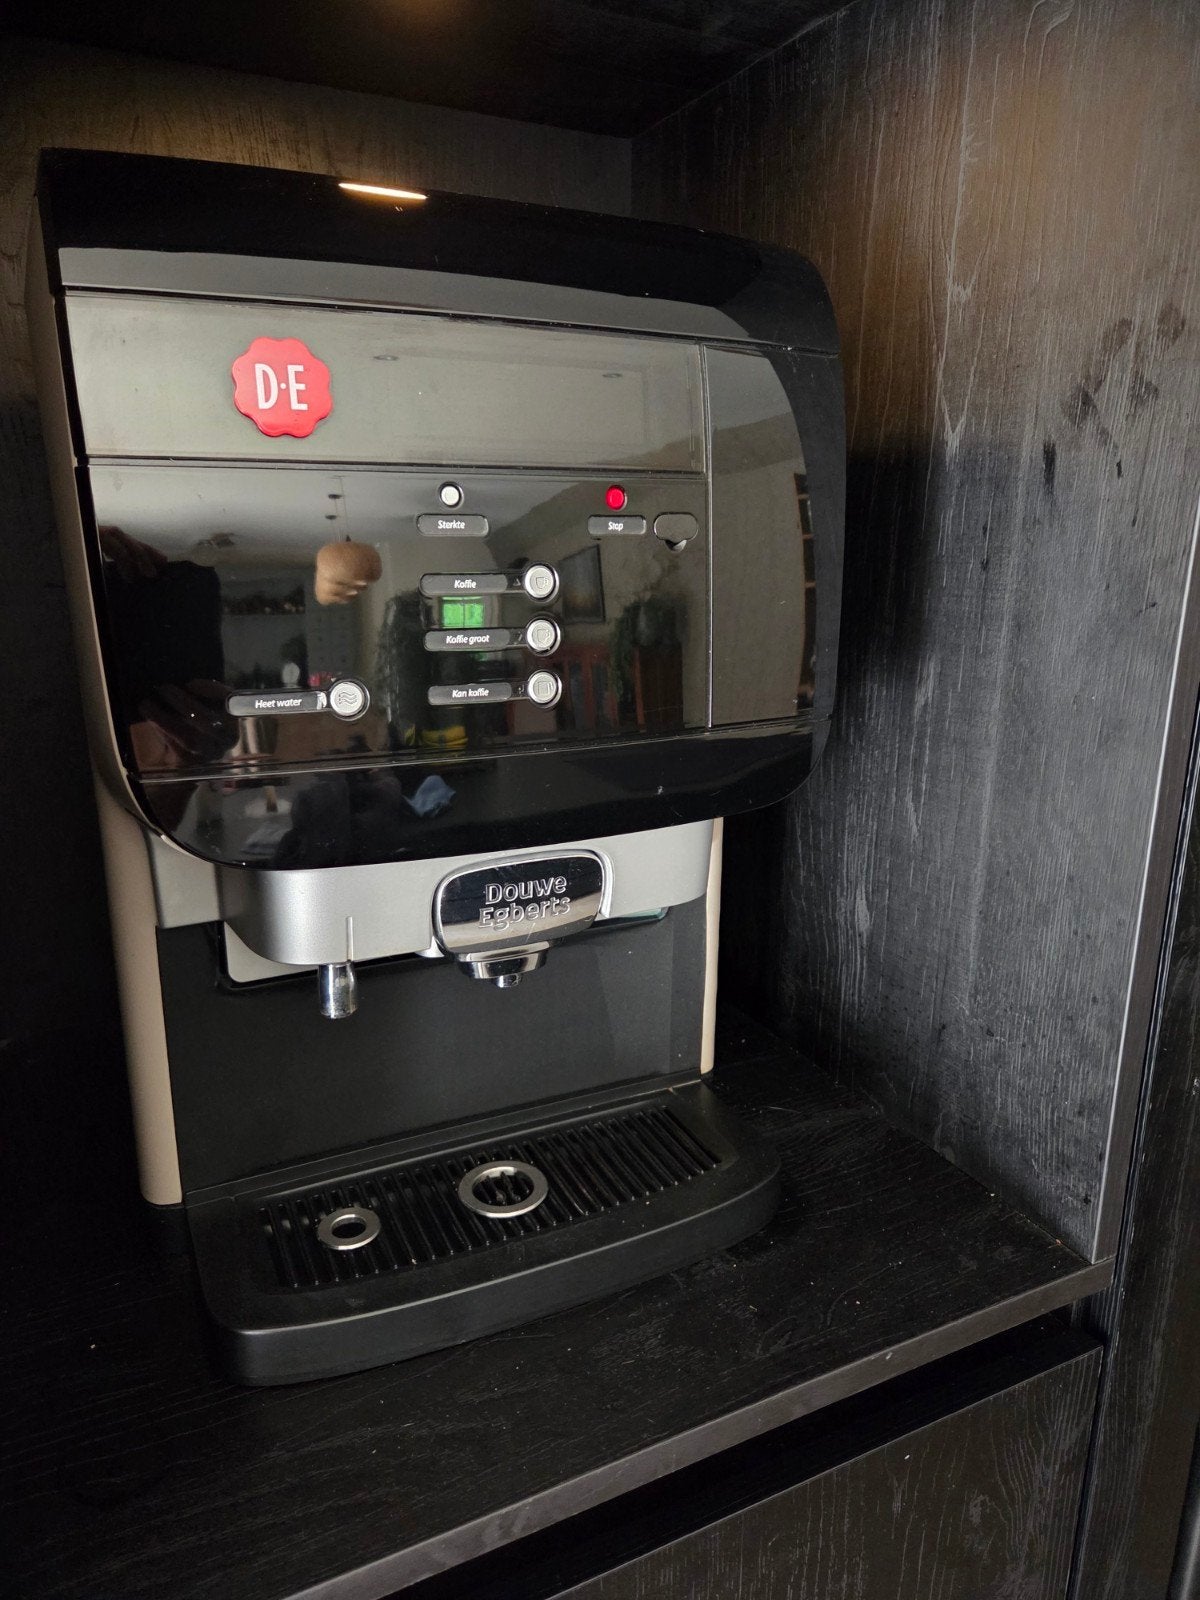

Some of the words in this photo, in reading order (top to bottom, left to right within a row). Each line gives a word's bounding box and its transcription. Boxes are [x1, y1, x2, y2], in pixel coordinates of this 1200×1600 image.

[437, 519, 466, 530] Sterkte
[607, 521, 624, 531] Stop
[453, 579, 477, 589] Koffie
[446, 634, 468, 644] Koffie
[469, 634, 489, 645] groot
[452, 689, 467, 698] Kan
[468, 688, 489, 698] koffie
[255, 699, 276, 709] Heet
[276, 698, 302, 708] water
[485, 875, 567, 905] Douwe
[478, 896, 571, 932] Egberts
